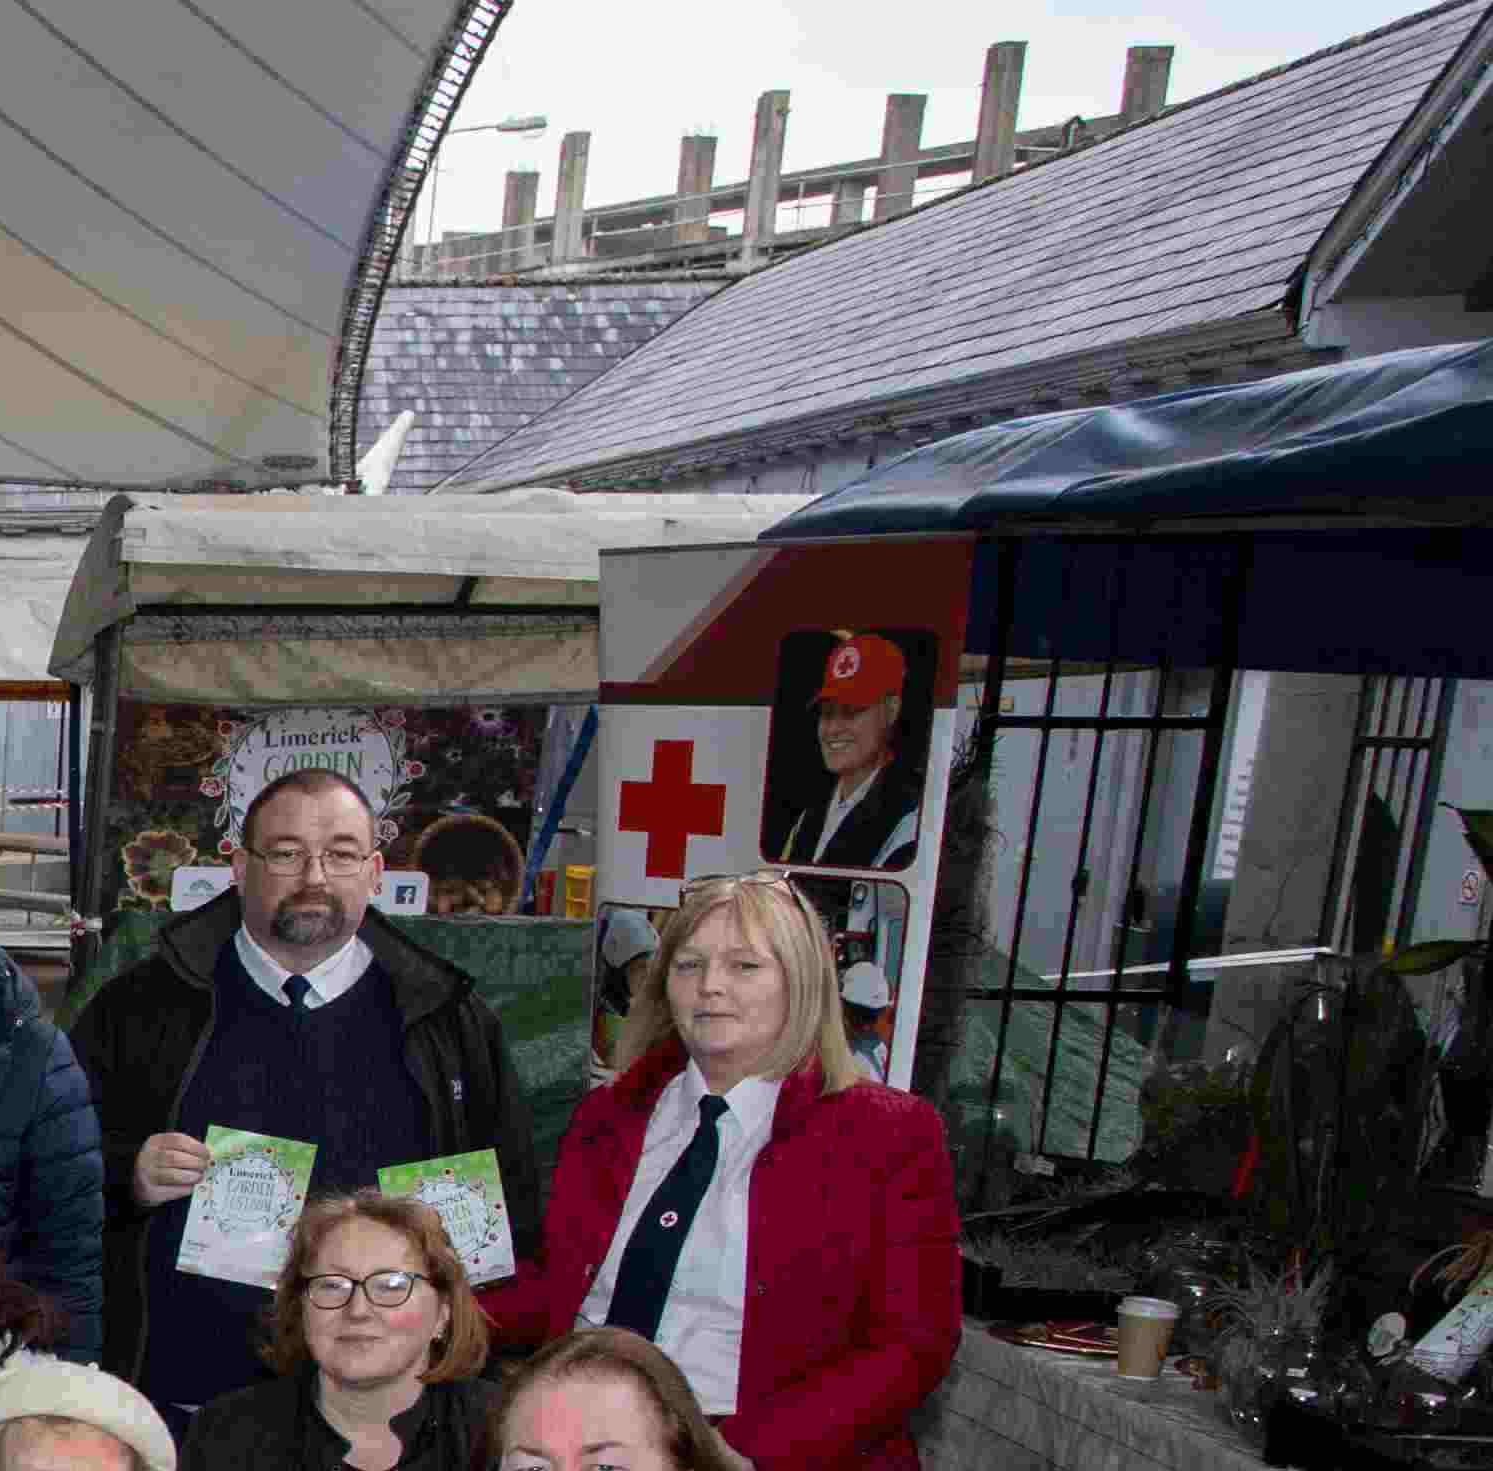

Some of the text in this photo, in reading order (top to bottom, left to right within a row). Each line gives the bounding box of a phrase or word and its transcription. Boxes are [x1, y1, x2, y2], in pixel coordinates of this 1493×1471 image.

[265, 725, 361, 748] Limerick
[229, 1166, 276, 1181] Limerick
[227, 1180, 275, 1197] GARDEN
